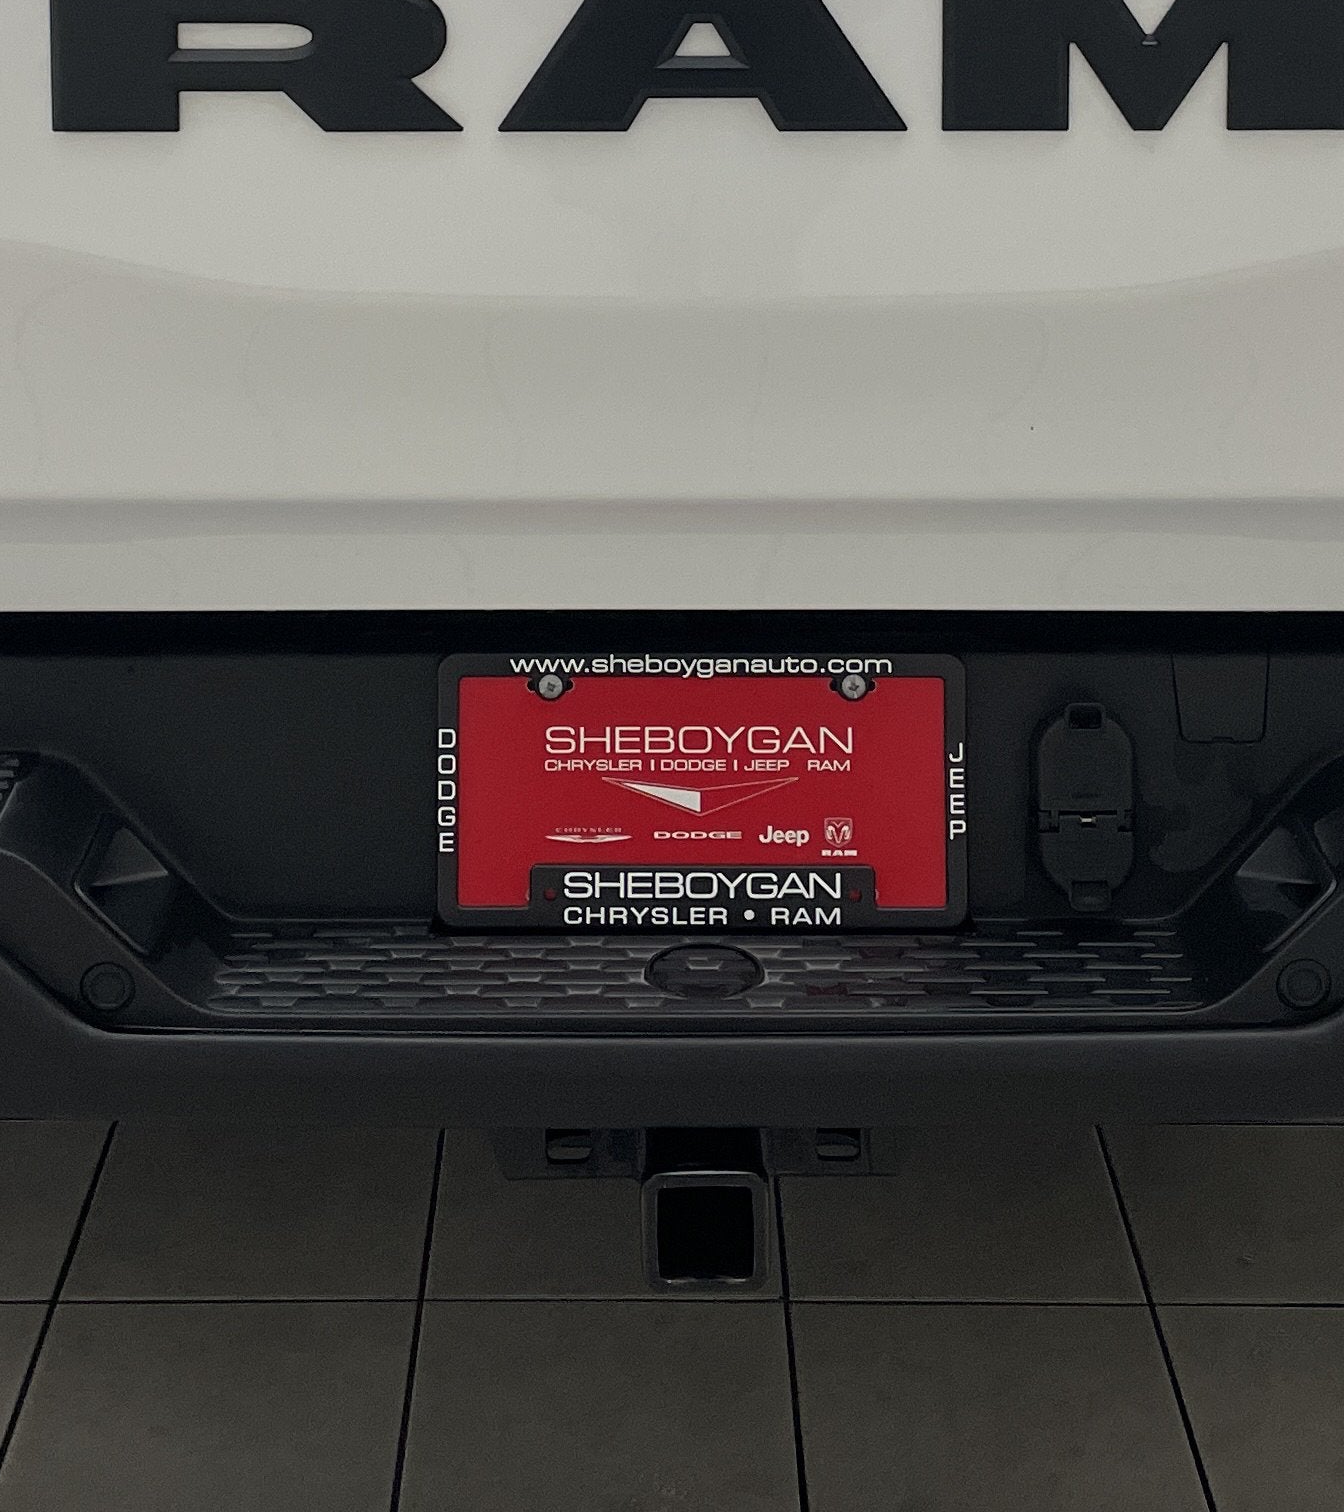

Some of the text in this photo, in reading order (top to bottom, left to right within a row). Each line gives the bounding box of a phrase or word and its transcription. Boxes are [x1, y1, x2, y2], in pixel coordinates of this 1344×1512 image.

[510, 654, 893, 678] www.sheboyganauto.com
[545, 726, 853, 754] SHEBOYGAN
[544, 759, 851, 771] CHRYSLER DODGE JEEP RAM
[438, 728, 457, 853] DODGE
[949, 742, 967, 841] JEEP
[653, 831, 742, 840] DODGE
[758, 825, 810, 847] Jeep
[821, 849, 858, 857] RAM
[563, 871, 841, 899] SHEBOYGAN
[563, 906, 841, 925] CHRYSLER RAM
